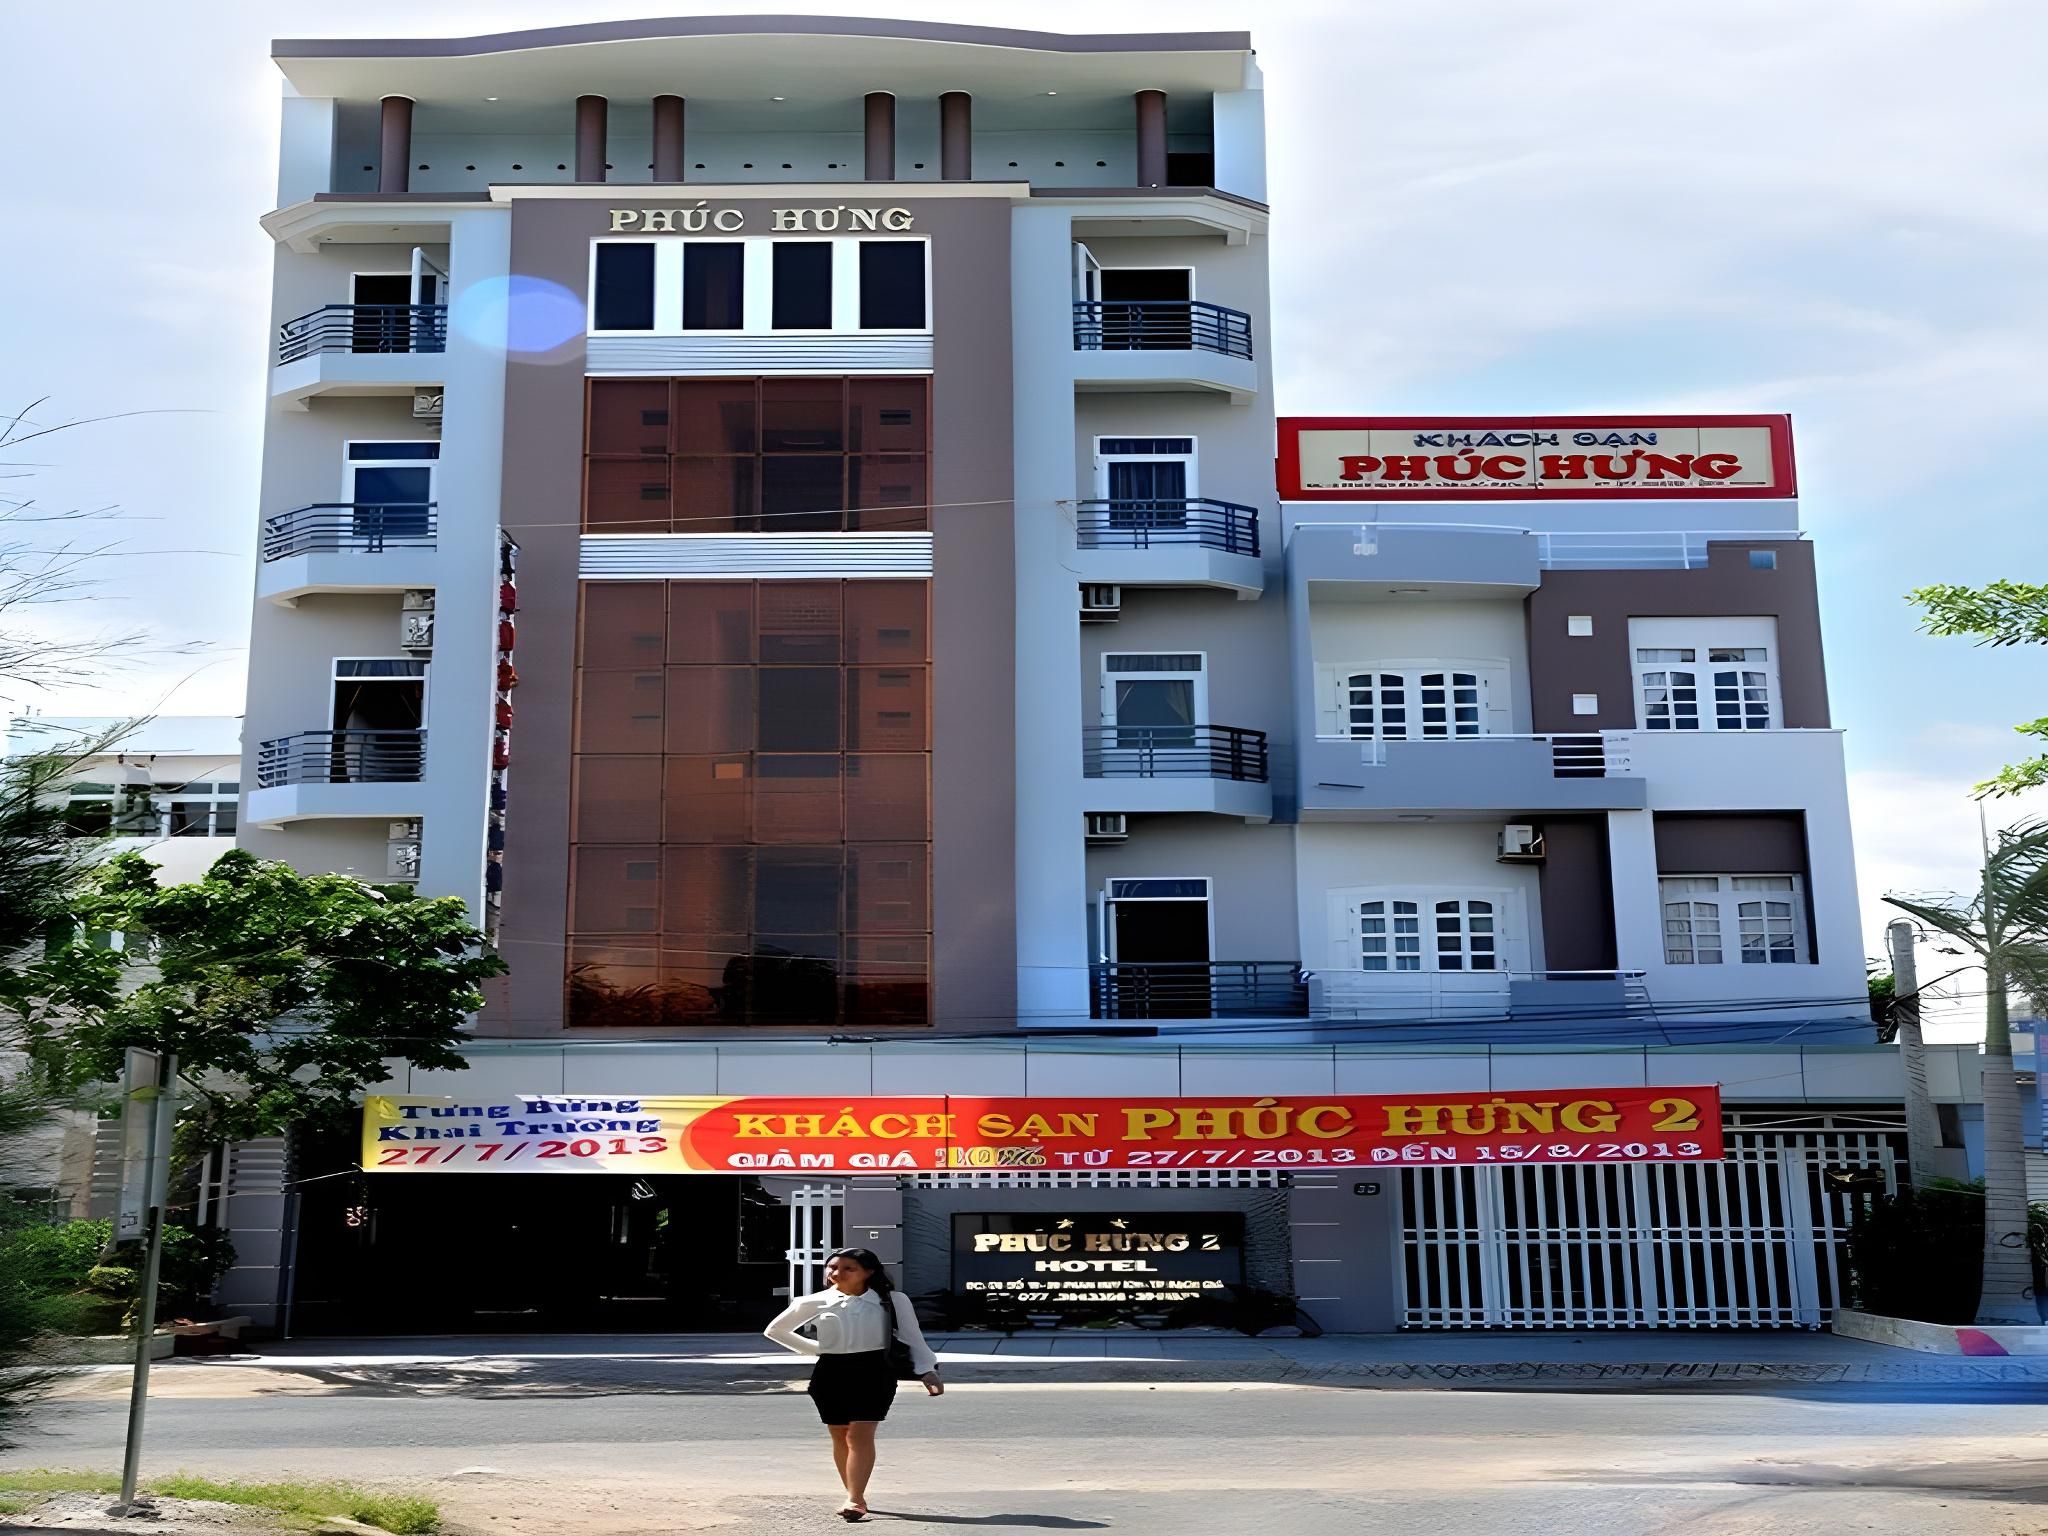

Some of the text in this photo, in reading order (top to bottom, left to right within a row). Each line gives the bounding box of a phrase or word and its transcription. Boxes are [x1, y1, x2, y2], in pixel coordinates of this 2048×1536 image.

[609, 200, 914, 232] PHÚC HƯNG
[1338, 448, 1743, 480] PHÚC HƯNG
[378, 1123, 483, 1141] Khai
[733, 1097, 1704, 1143] KHÁCH SẠN PHÚC HƯNG 2
[378, 1136, 668, 1166] 27/7/2013
[1127, 1148, 1357, 1166] 27/7/2013
[1475, 1142, 1703, 1161] 15/8/2013
[973, 1228, 1072, 1253] PHÚC
[1200, 1233, 1221, 1252] 2
[1034, 1259, 1158, 1273] HOTEL
